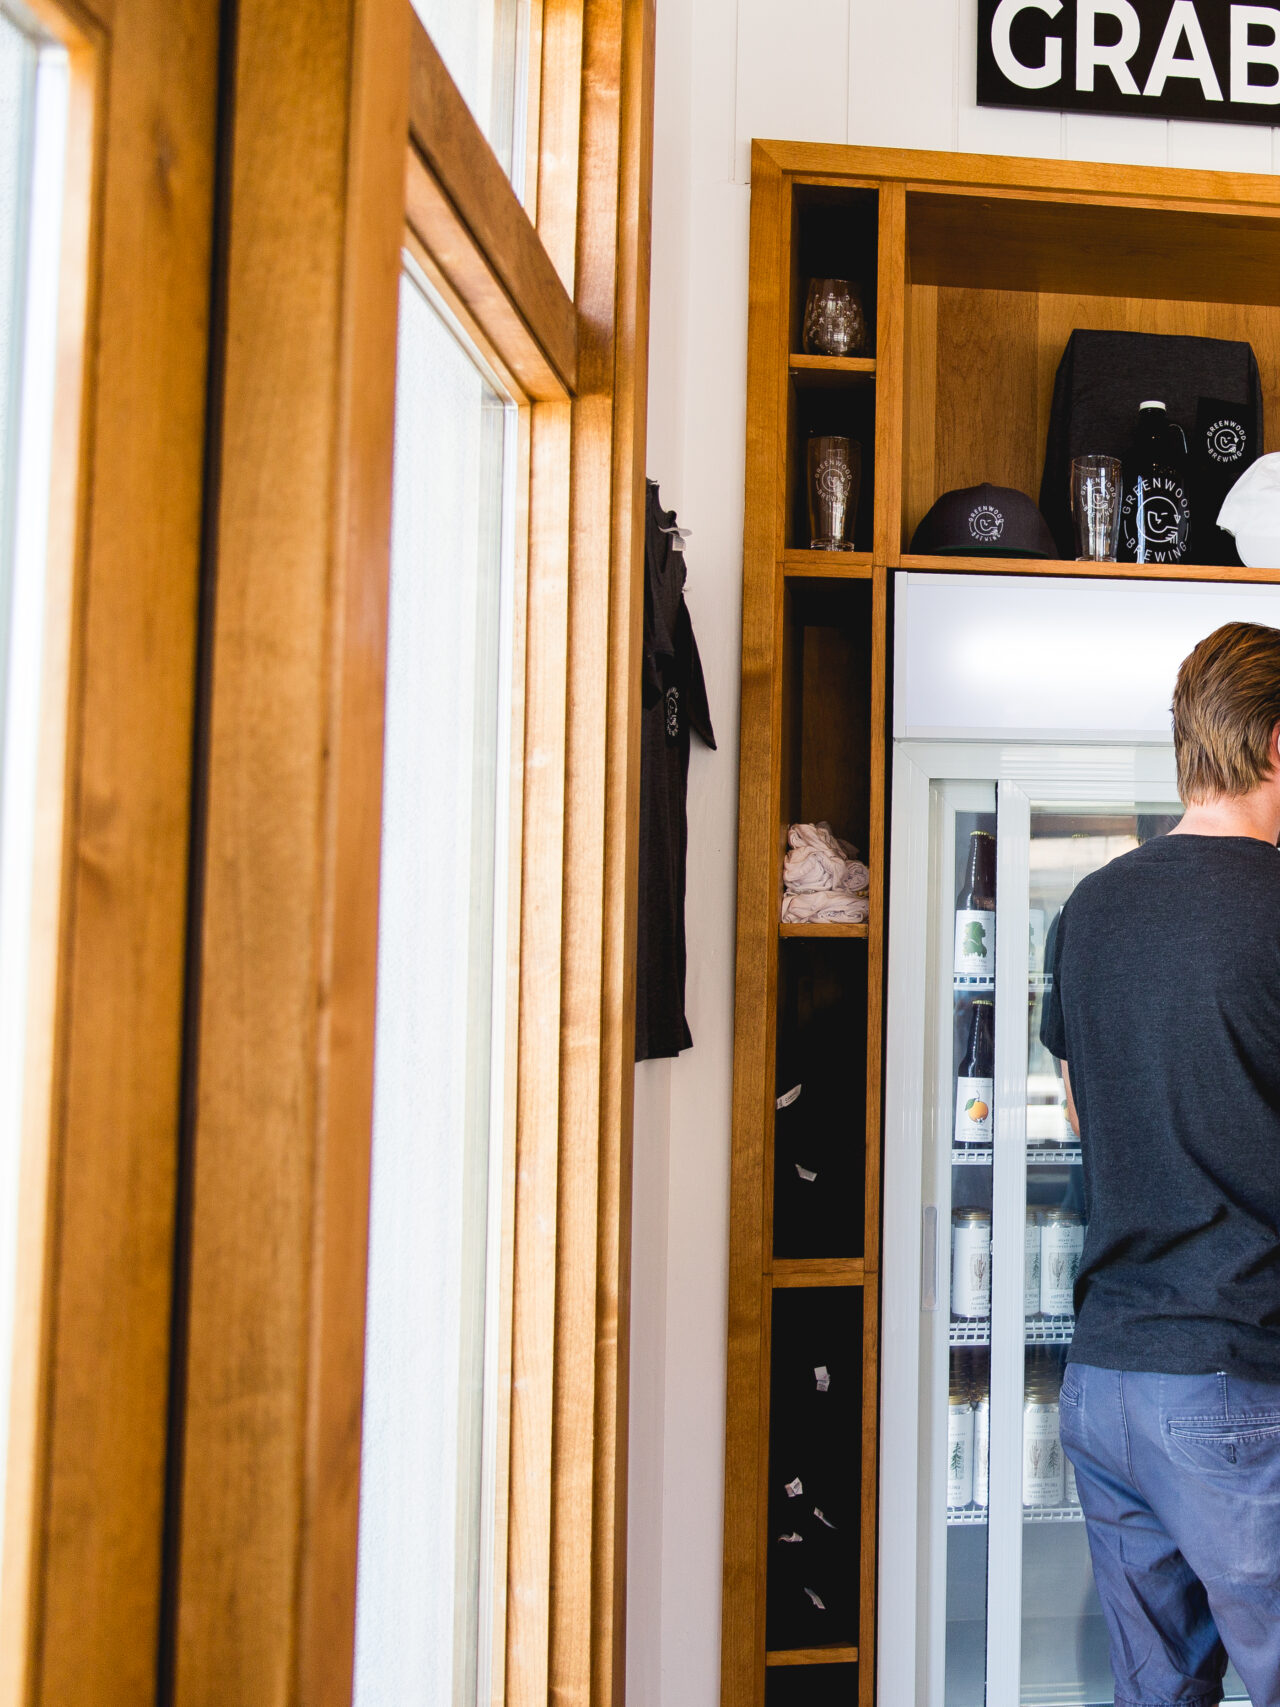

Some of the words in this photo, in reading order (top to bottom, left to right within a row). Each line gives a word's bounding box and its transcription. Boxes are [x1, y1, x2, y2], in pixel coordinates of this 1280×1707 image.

[1206, 420, 1247, 441] GREENWOOD
[1208, 448, 1242, 462] BREWING
[814, 460, 852, 480] GREENWOOD
[1122, 477, 1190, 519] GREENWOOD
[968, 505, 1005, 522] GREENWOOD
[1126, 537, 1187, 563] BREWING
